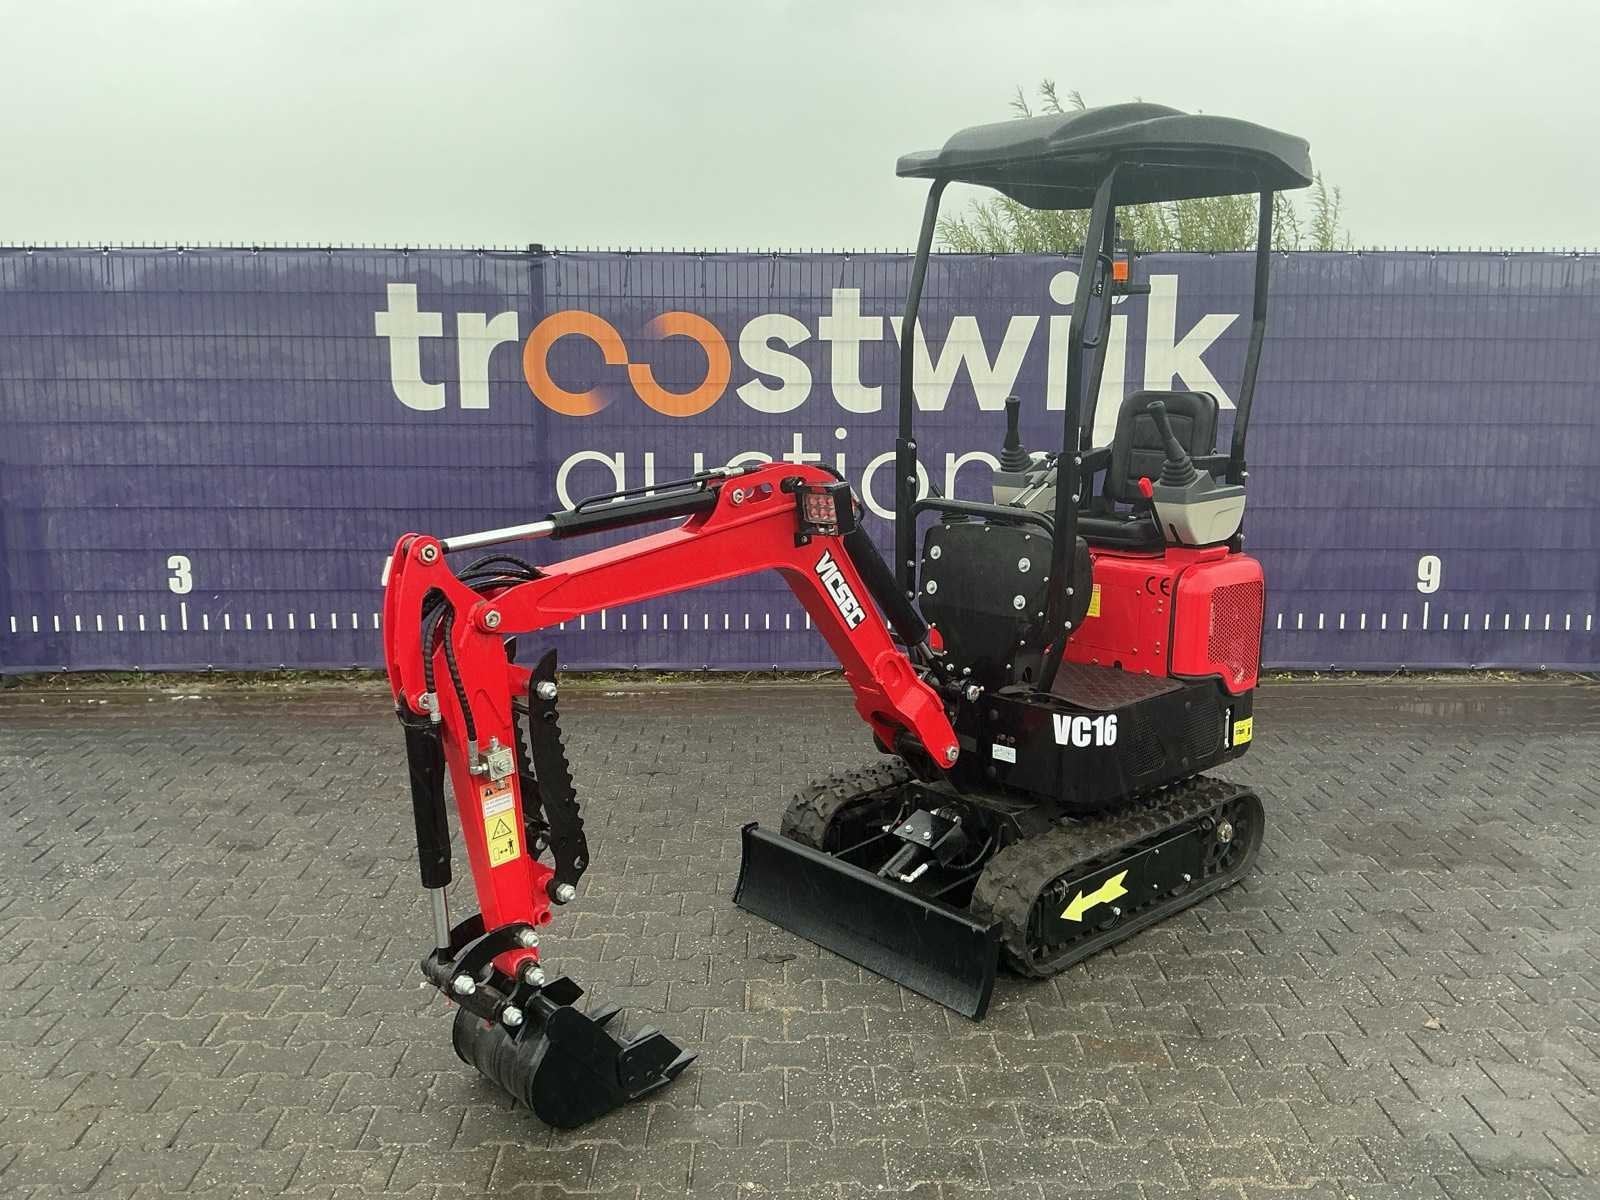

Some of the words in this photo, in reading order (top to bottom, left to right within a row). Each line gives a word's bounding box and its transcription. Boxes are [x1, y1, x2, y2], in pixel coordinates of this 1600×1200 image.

[375, 270, 1240, 448] troostwijk
[556, 427, 1058, 520] aution
[168, 555, 193, 594] 3
[815, 550, 866, 630] VICSEC
[1145, 575, 1170, 597] CE
[1416, 555, 1441, 594] 9
[1053, 713, 1118, 748] VC16
